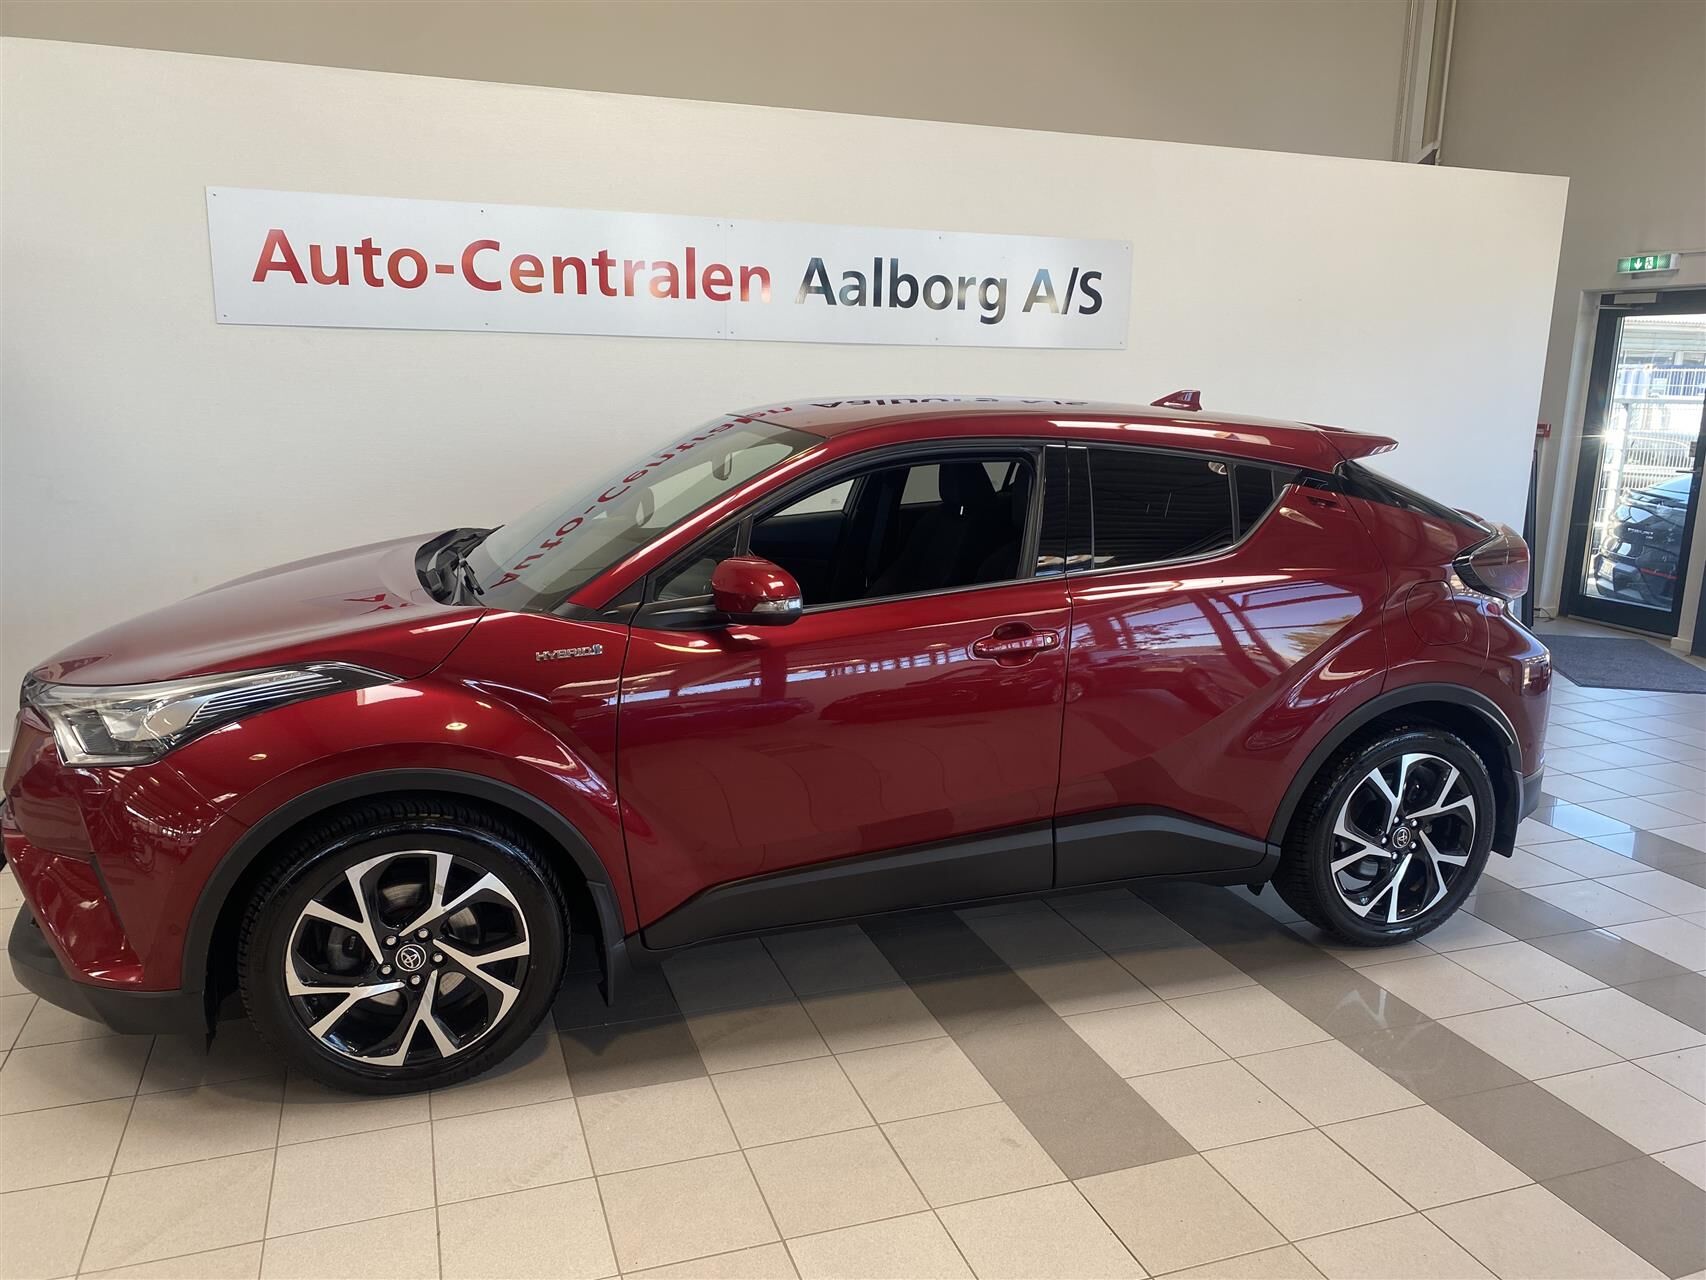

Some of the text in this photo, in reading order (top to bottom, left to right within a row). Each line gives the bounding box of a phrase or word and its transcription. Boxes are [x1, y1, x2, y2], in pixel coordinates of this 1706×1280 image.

[251, 228, 1103, 325] Auto-Centralen Aalborg A/S
[535, 646, 592, 662] HYBRID
